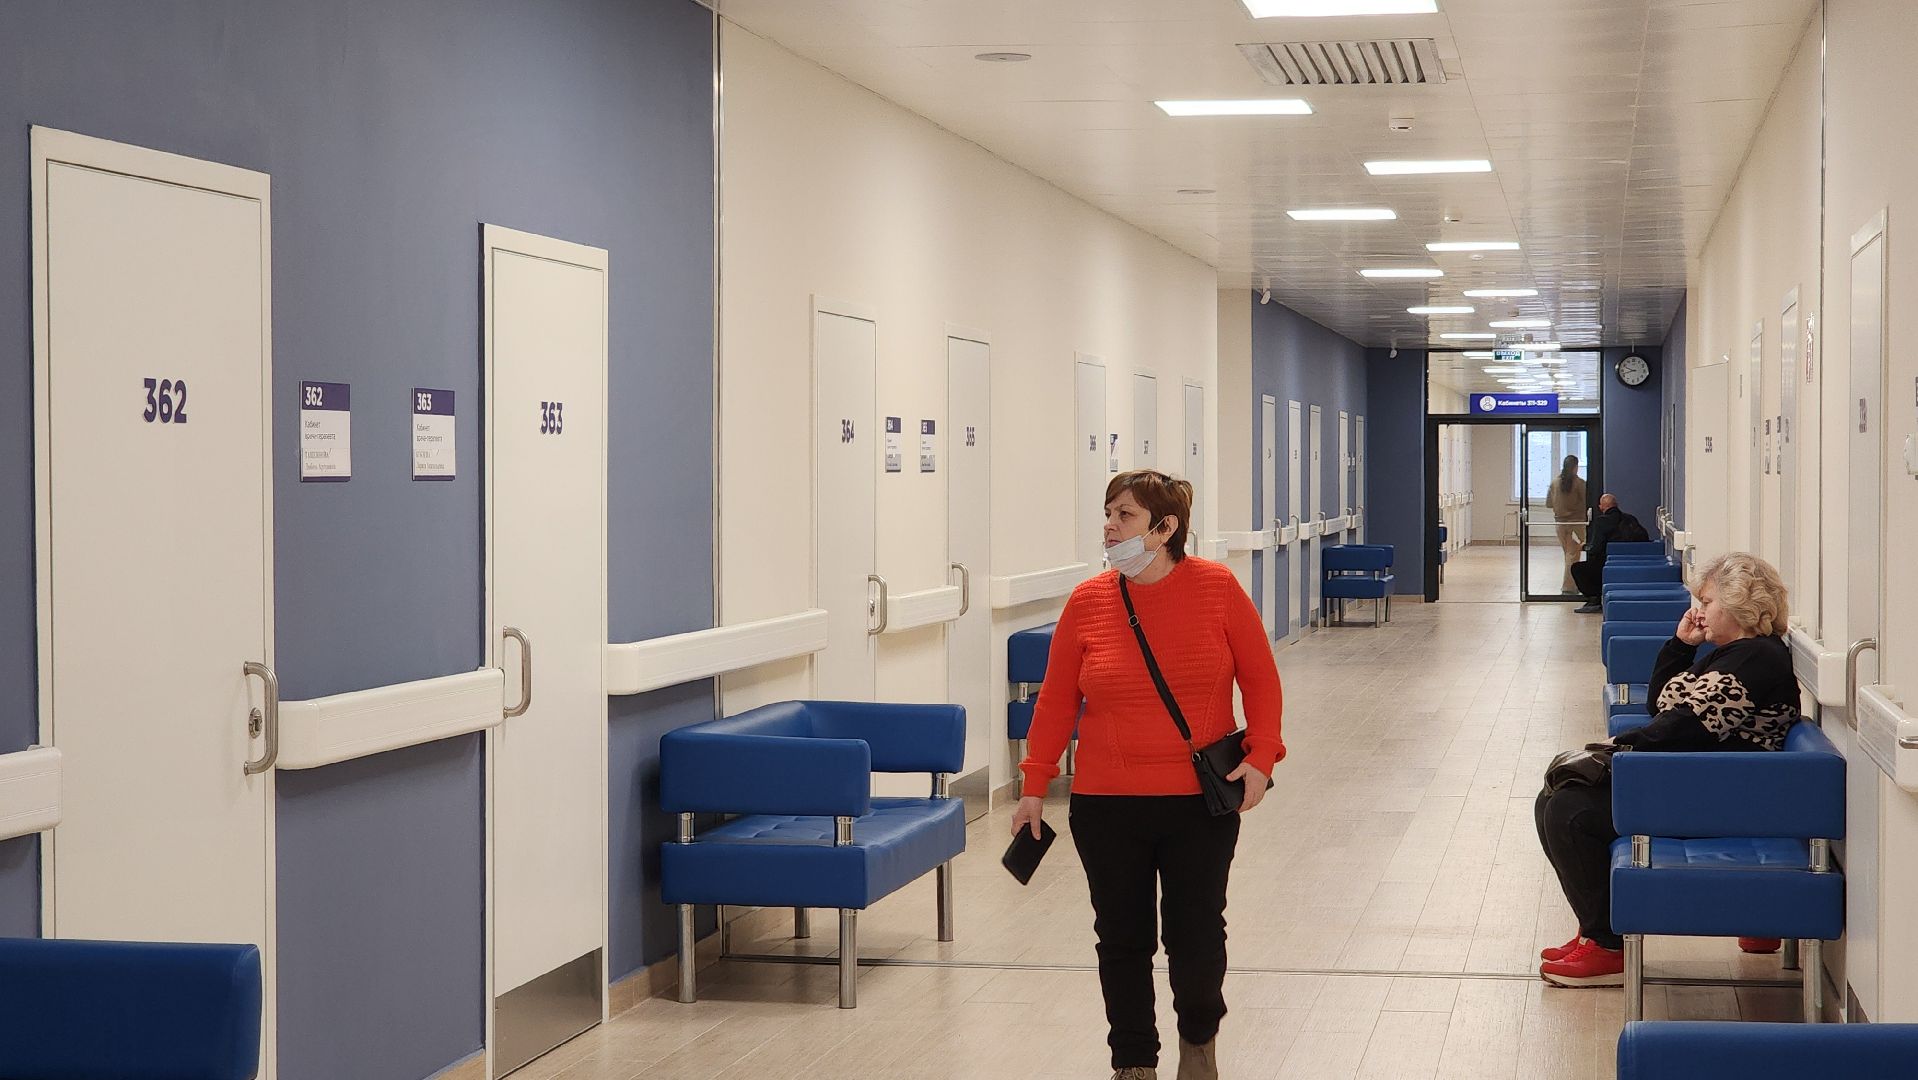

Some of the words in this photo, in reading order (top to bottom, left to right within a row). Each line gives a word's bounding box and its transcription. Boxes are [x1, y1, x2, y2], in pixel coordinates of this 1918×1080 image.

[144, 378, 187, 423] 362
[305, 387, 323, 406] 362
[417, 393, 432, 411] 363
[541, 402, 563, 434] 363
[842, 419, 855, 443] 364
